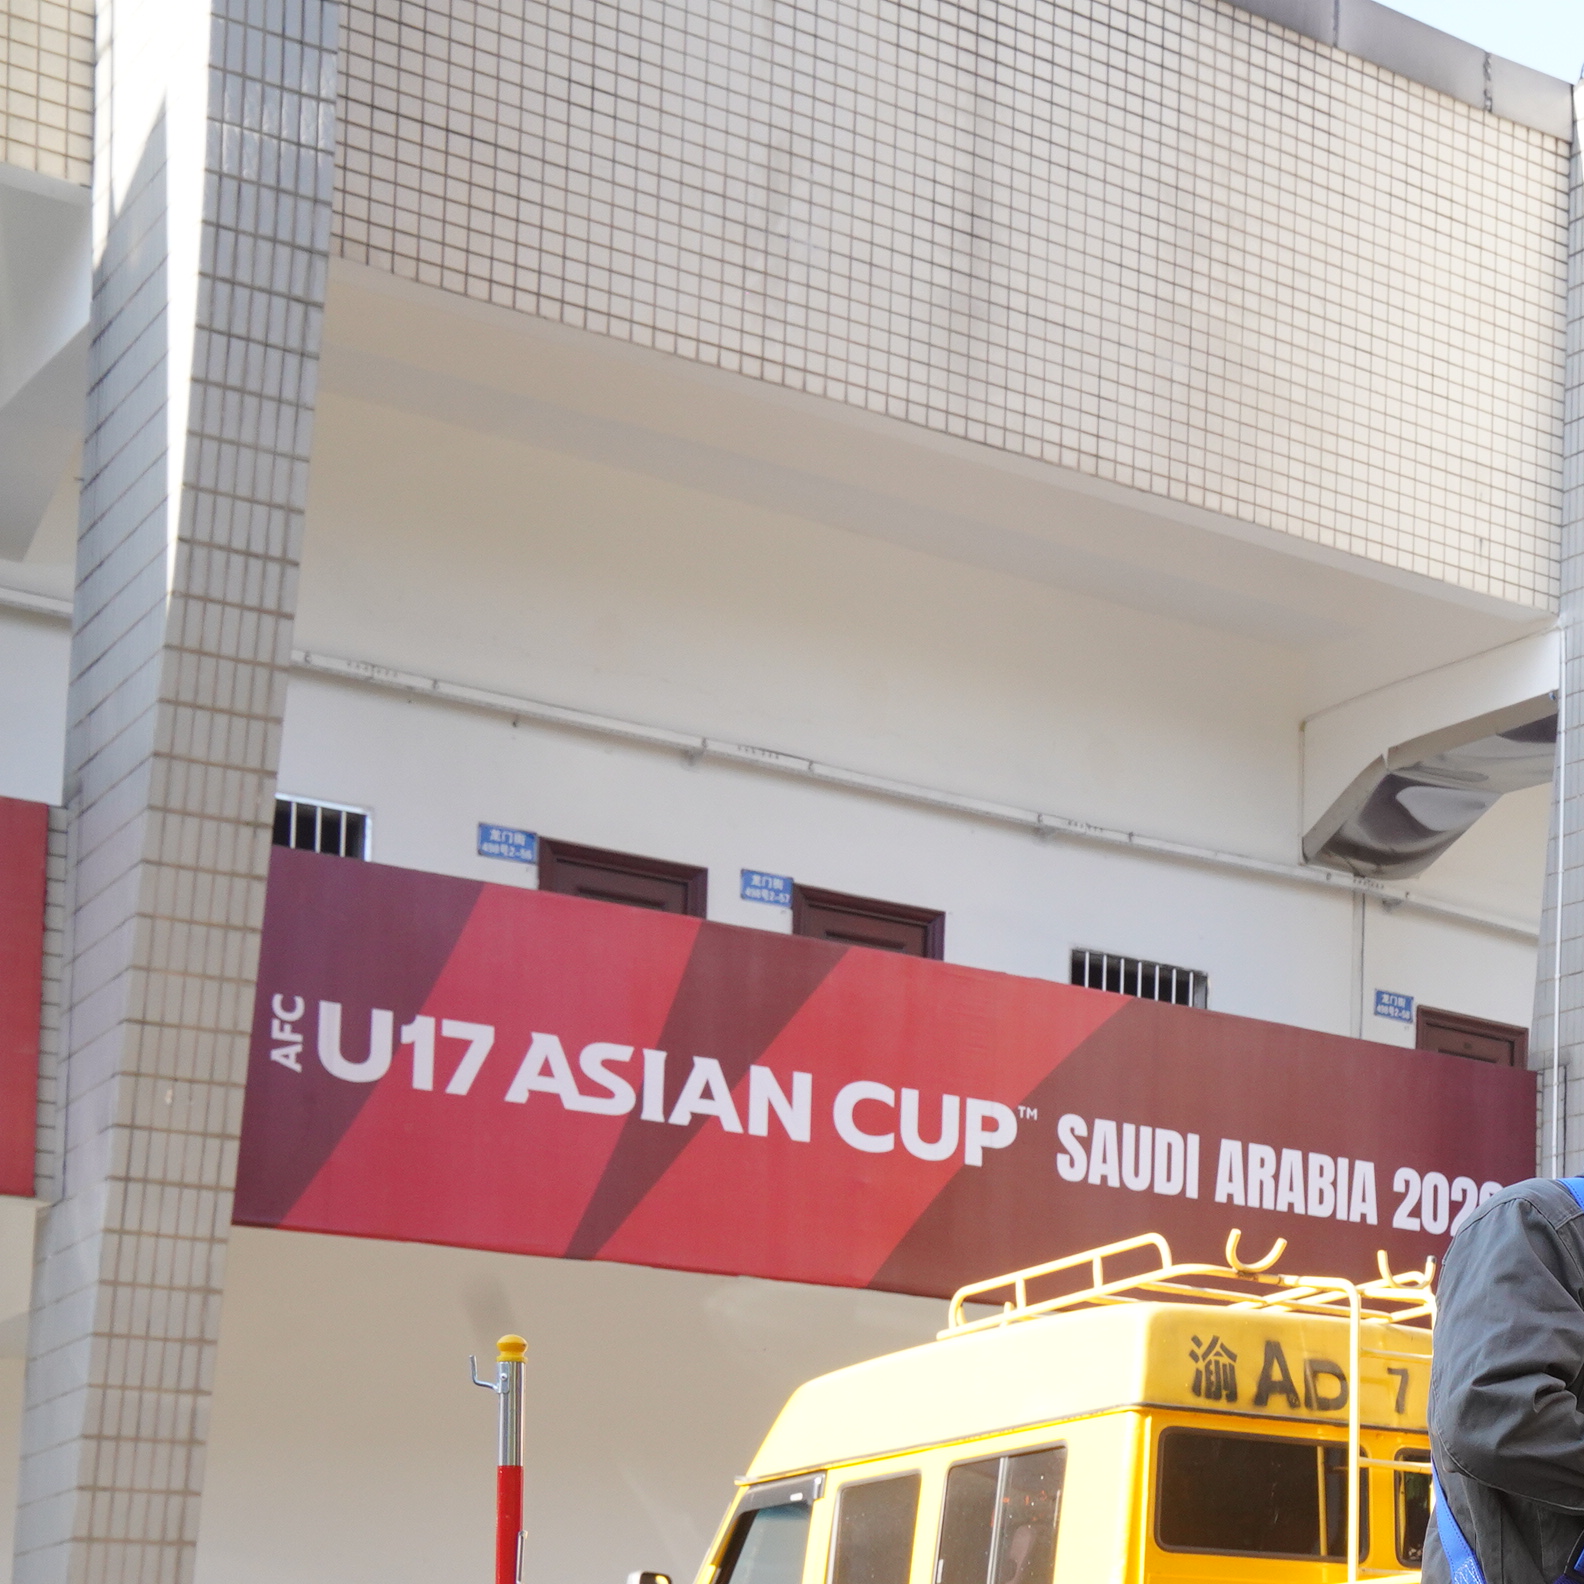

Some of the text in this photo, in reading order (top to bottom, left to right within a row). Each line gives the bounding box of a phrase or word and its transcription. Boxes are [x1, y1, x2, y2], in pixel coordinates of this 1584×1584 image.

[270, 993, 305, 1073] AFC
[317, 1000, 496, 1096] U17
[503, 1030, 813, 1144] ASIAN
[1056, 1112, 1200, 1200] SAUDI
[1214, 1137, 1379, 1226] ARABIA
